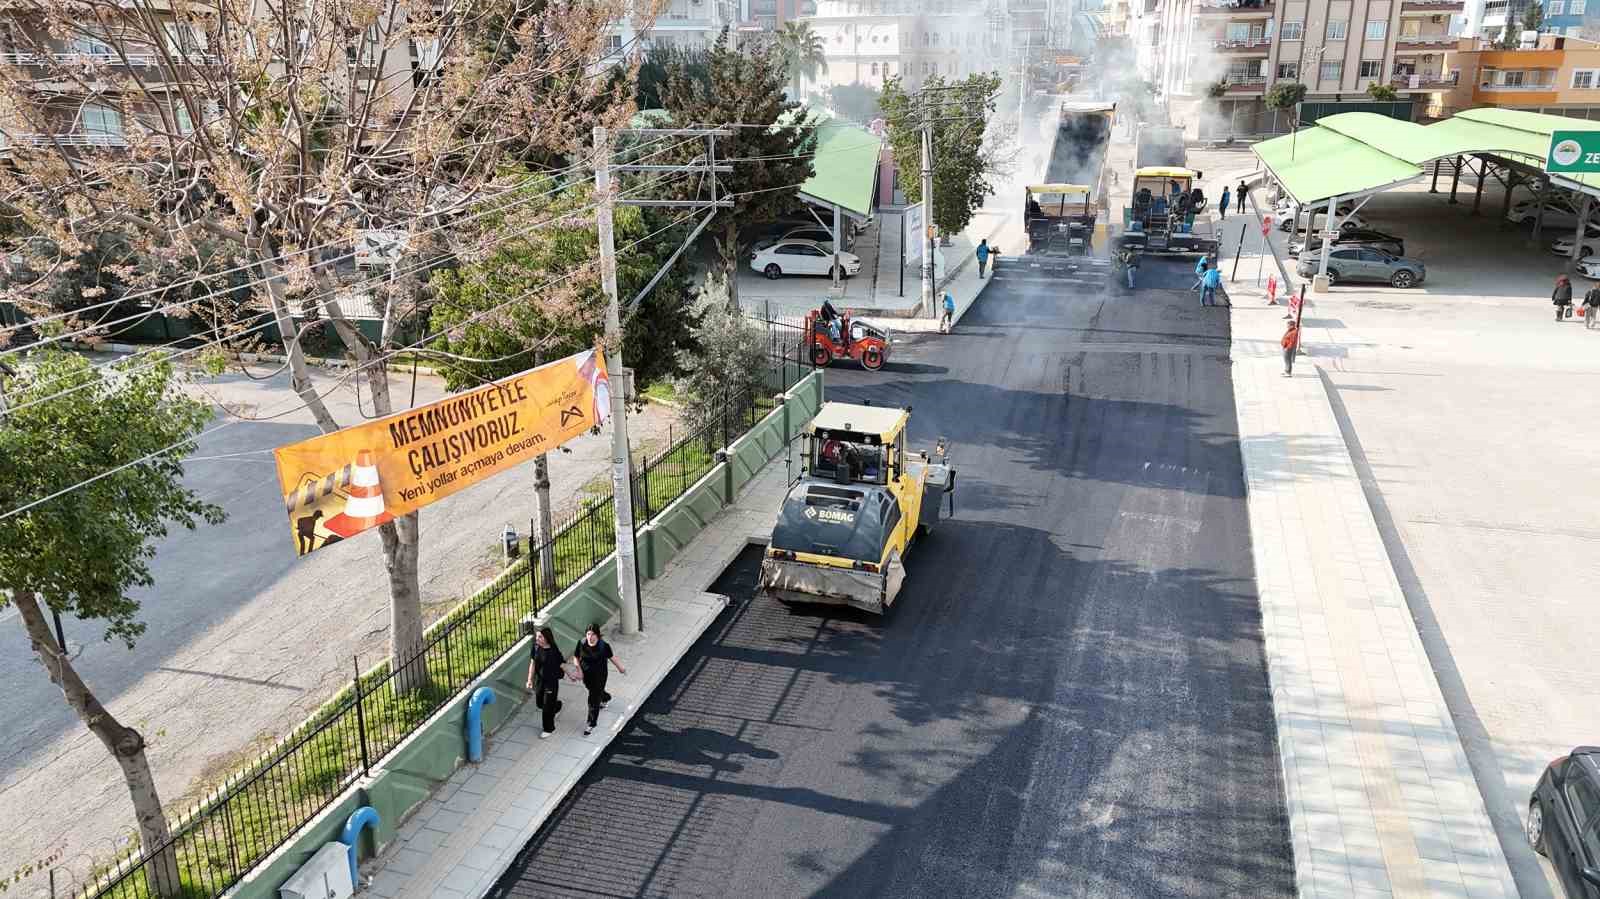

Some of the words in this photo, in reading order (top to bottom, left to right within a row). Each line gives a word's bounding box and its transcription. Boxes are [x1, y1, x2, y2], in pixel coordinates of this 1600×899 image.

[398, 484, 426, 503] Yeni
[427, 469, 459, 494] yollar
[460, 451, 505, 478] açmaya
[505, 435, 547, 457] devam.
[407, 411, 525, 480] ÇALIŞIYORUZ.
[818, 510, 854, 522] BOMAG
